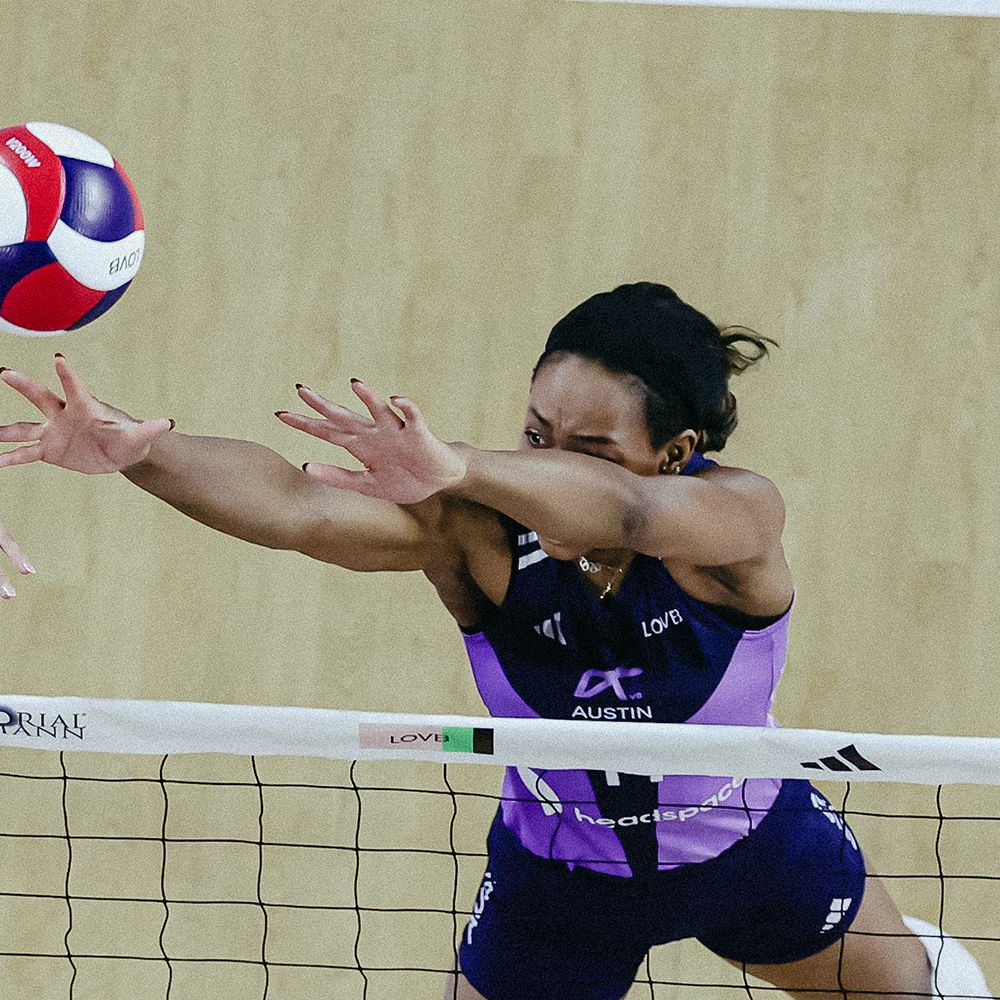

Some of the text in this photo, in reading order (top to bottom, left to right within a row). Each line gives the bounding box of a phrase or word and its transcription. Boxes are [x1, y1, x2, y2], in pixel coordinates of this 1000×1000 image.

[109, 247, 140, 275] LOVB
[641, 608, 683, 638] LOVB
[571, 705, 653, 720] AUSTIN
[390, 733, 450, 744] LOVB
